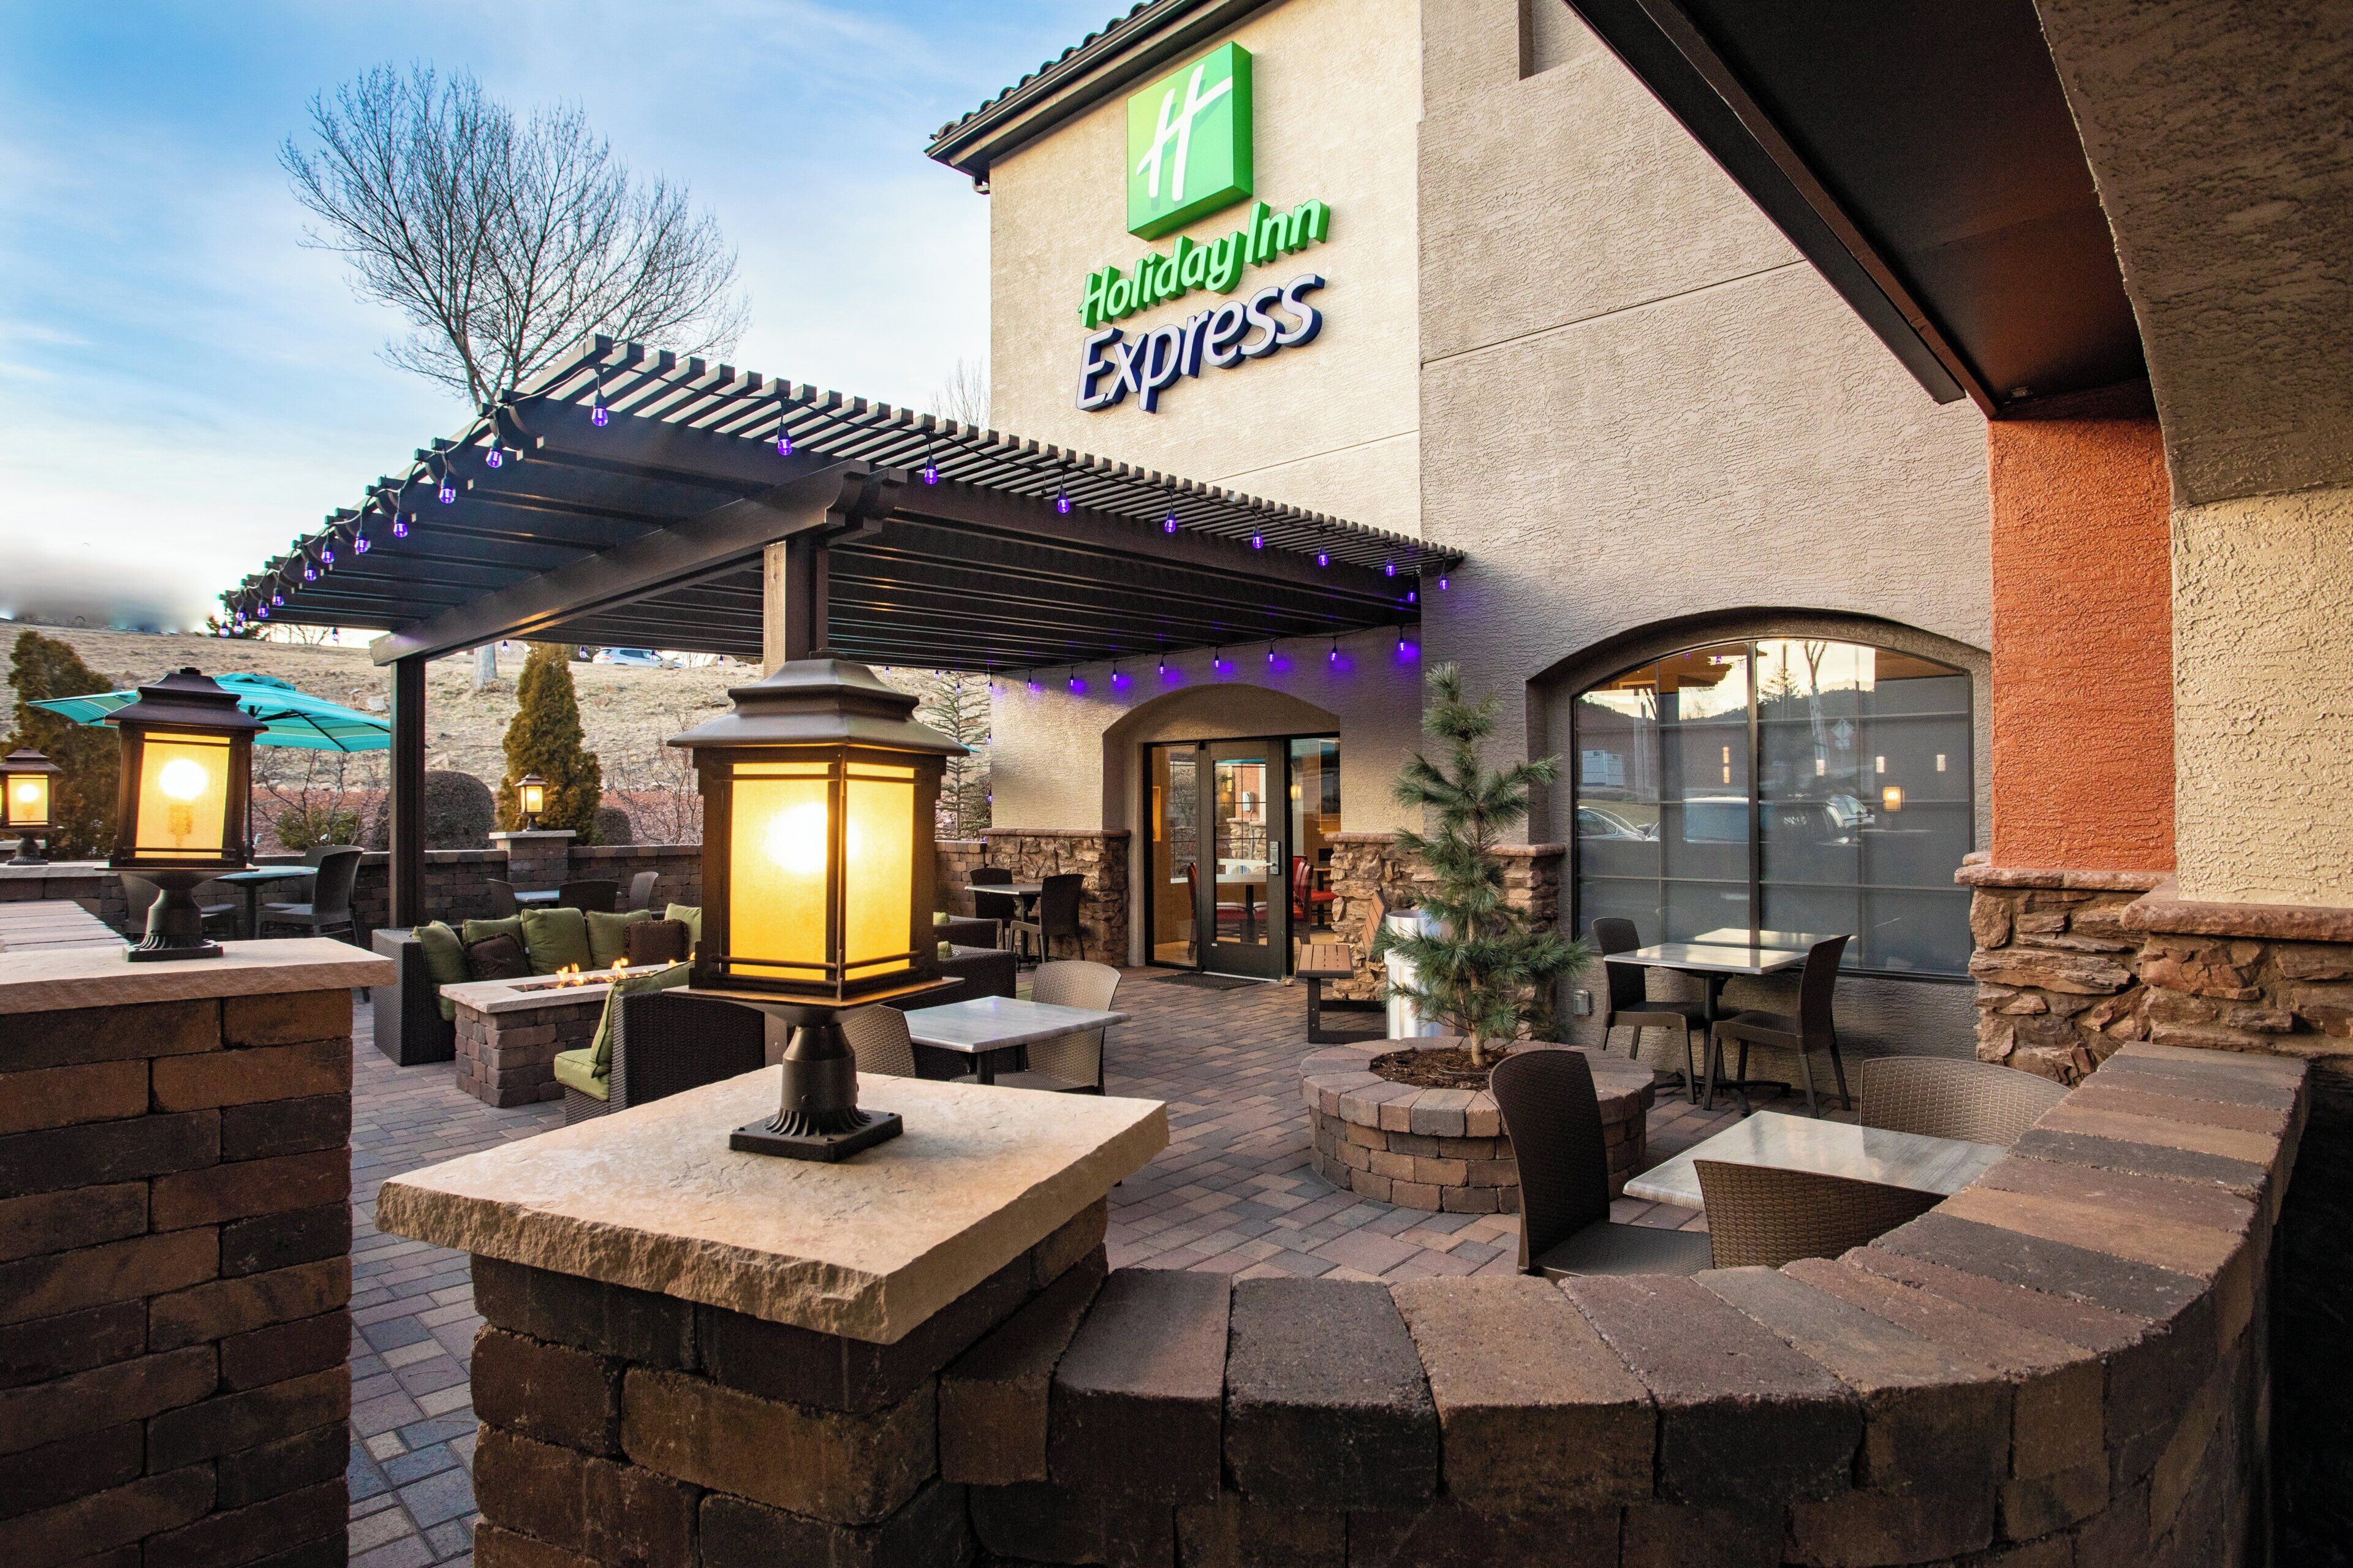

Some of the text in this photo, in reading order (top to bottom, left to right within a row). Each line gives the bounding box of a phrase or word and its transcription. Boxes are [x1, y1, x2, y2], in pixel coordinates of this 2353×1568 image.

[1137, 64, 1233, 200] H
[1078, 199, 1330, 329] Holiday Inn
[1076, 274, 1325, 413] Express
